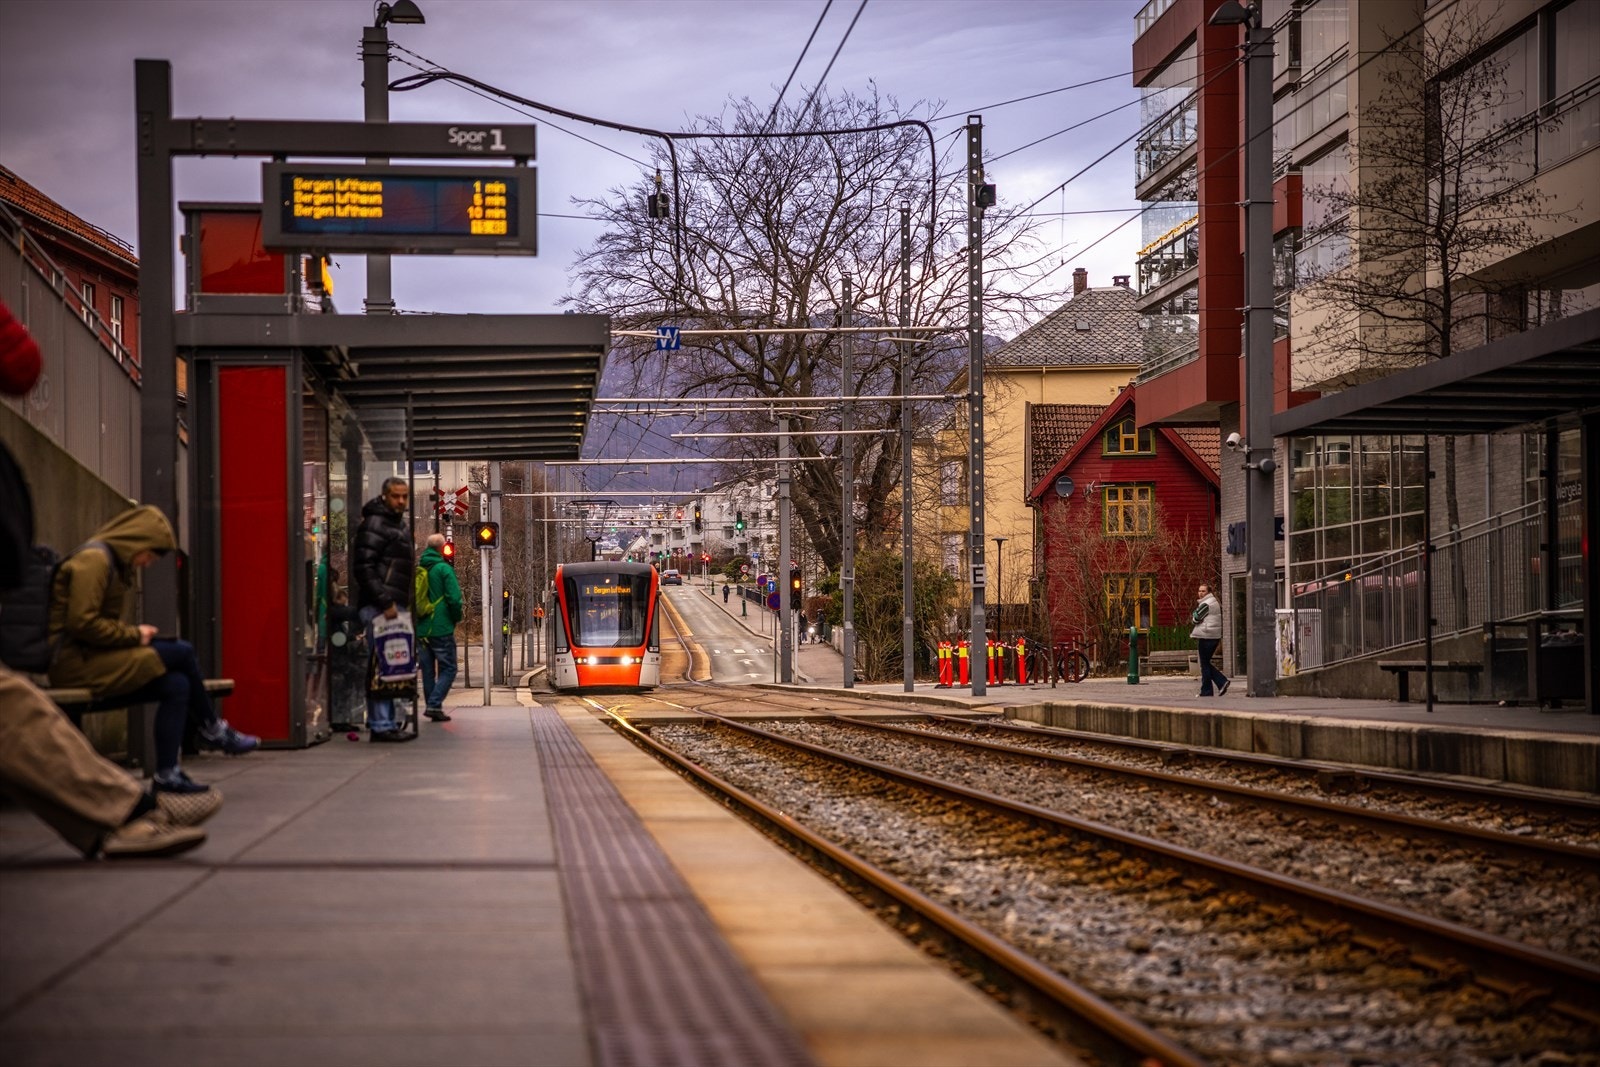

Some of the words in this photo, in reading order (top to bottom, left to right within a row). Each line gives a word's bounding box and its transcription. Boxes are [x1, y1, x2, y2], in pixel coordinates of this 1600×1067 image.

[448, 127, 487, 146] Spor
[490, 128, 506, 150] 1
[473, 180, 481, 192] 1
[485, 181, 506, 193] min
[485, 194, 506, 206] min
[485, 207, 506, 219] min
[973, 567, 984, 584] E
